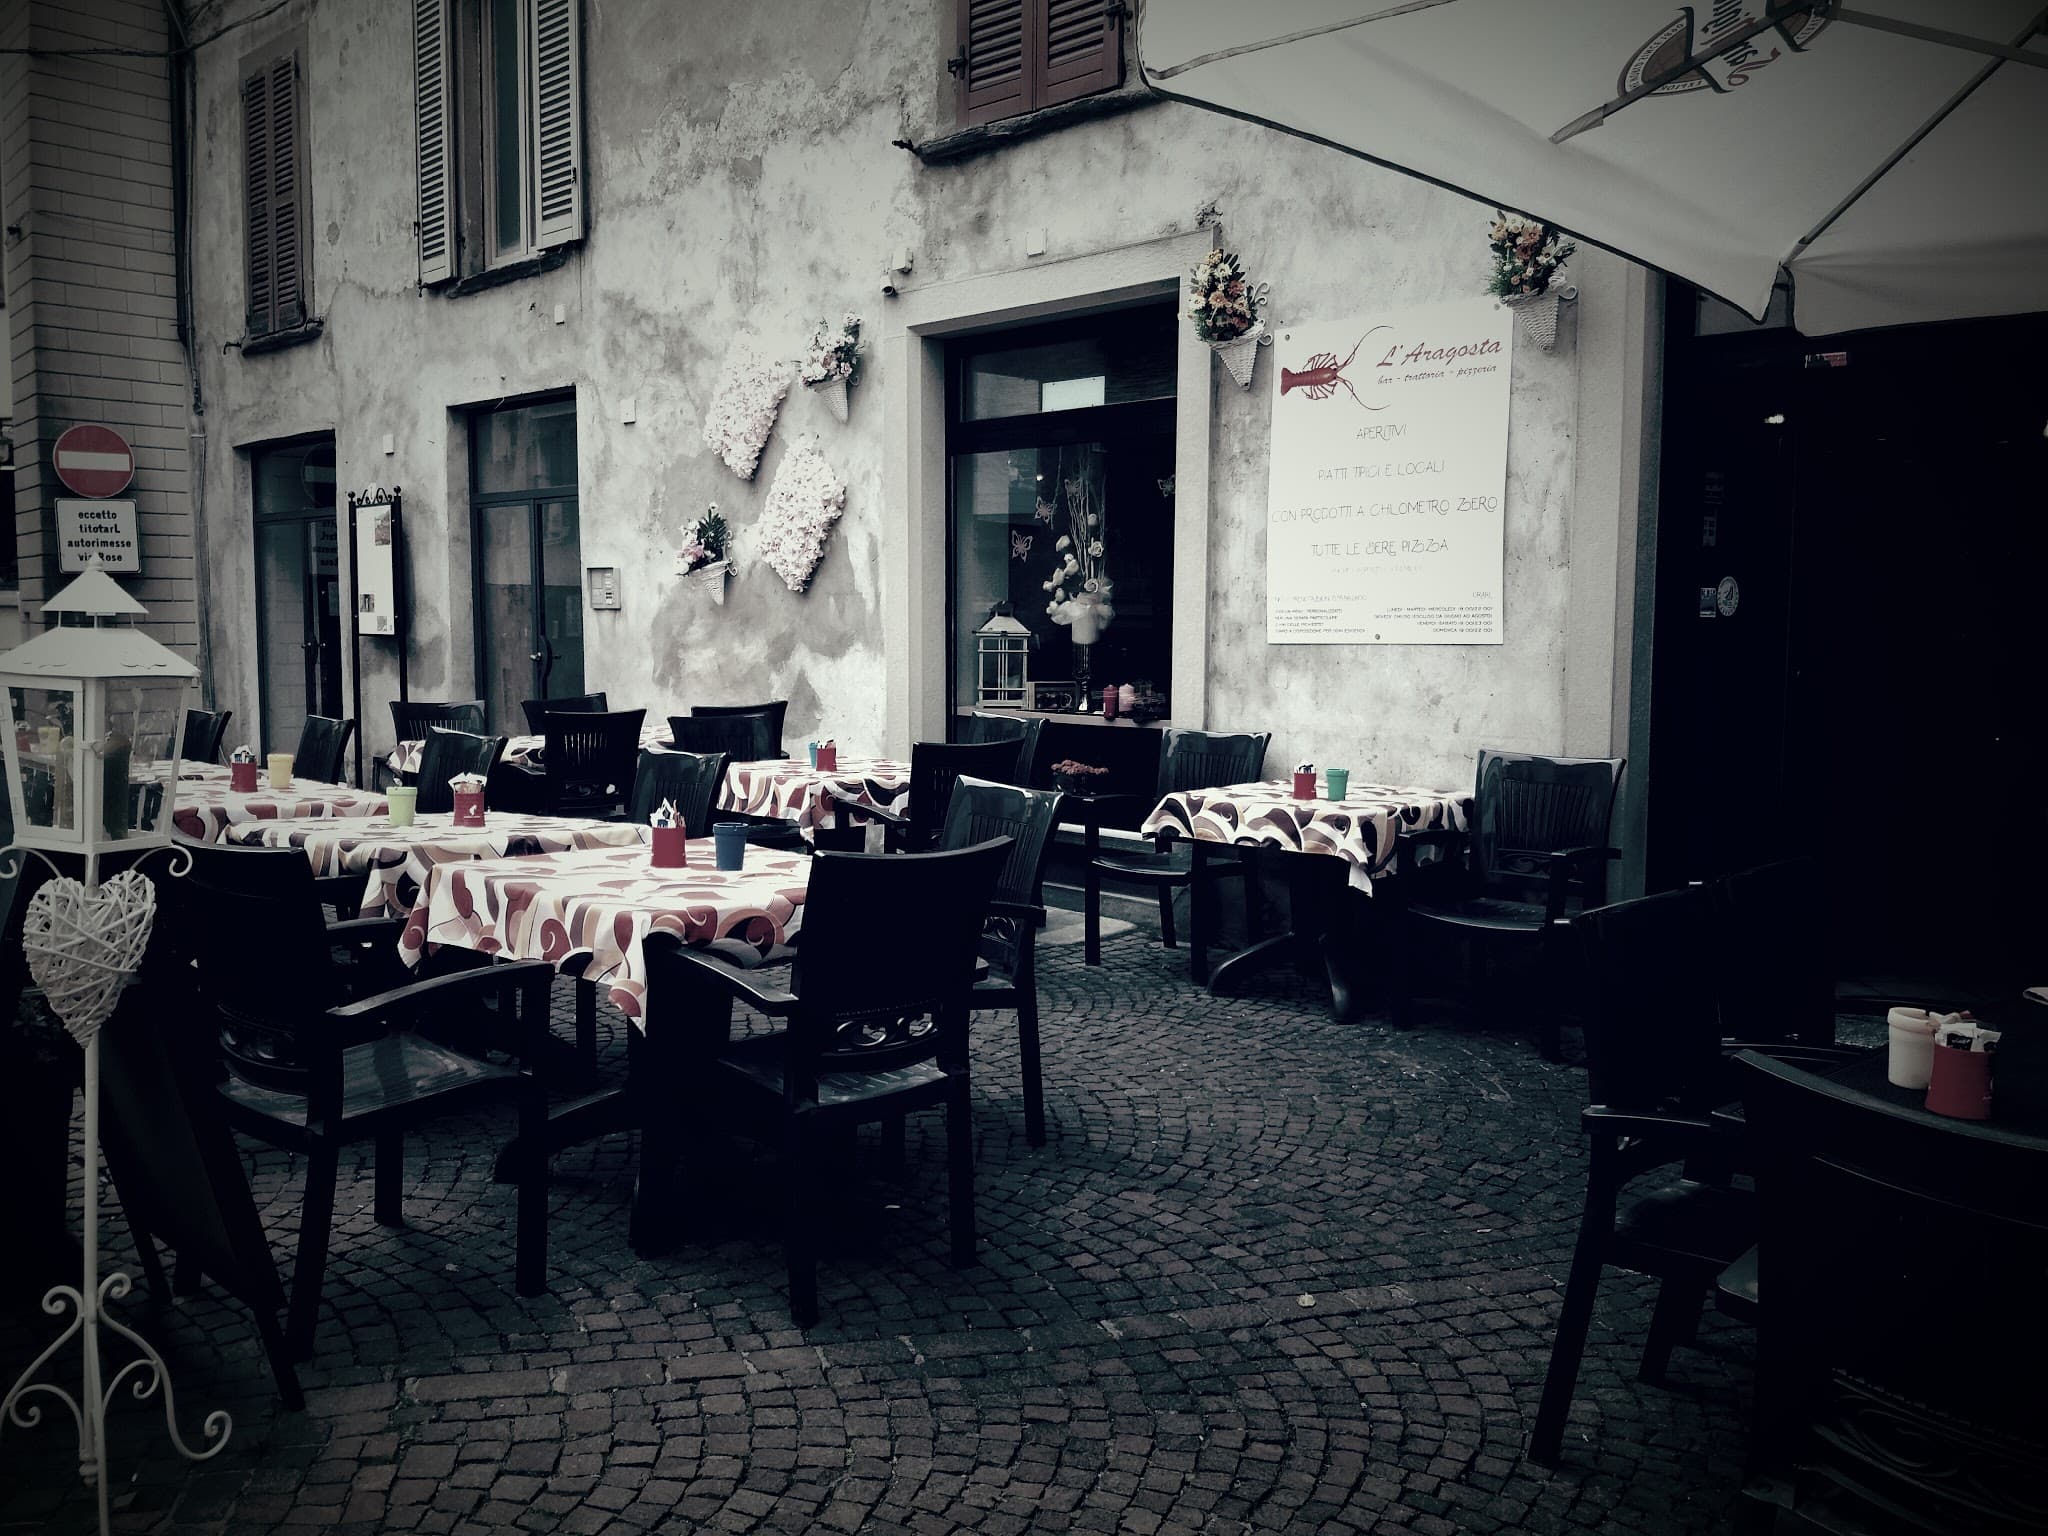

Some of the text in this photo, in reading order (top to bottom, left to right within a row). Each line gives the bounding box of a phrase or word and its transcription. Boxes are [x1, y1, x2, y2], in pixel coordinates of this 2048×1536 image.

[1375, 337, 1504, 368] L'Aragosta
[1377, 364, 1497, 385] bar trattoria pizzeria
[1355, 423, 1408, 441] APERITIVI
[1384, 463, 1393, 477] E
[1397, 459, 1445, 477] LOCALI
[78, 509, 118, 520] eccetto
[1272, 496, 1499, 523] CON PRODOTTI A CHILOMETRO ZERO
[67, 537, 132, 548] autorimesse
[1311, 543, 1342, 557] TUTTE
[1345, 542, 1361, 556] LE
[1401, 537, 1449, 554] PIZZA
